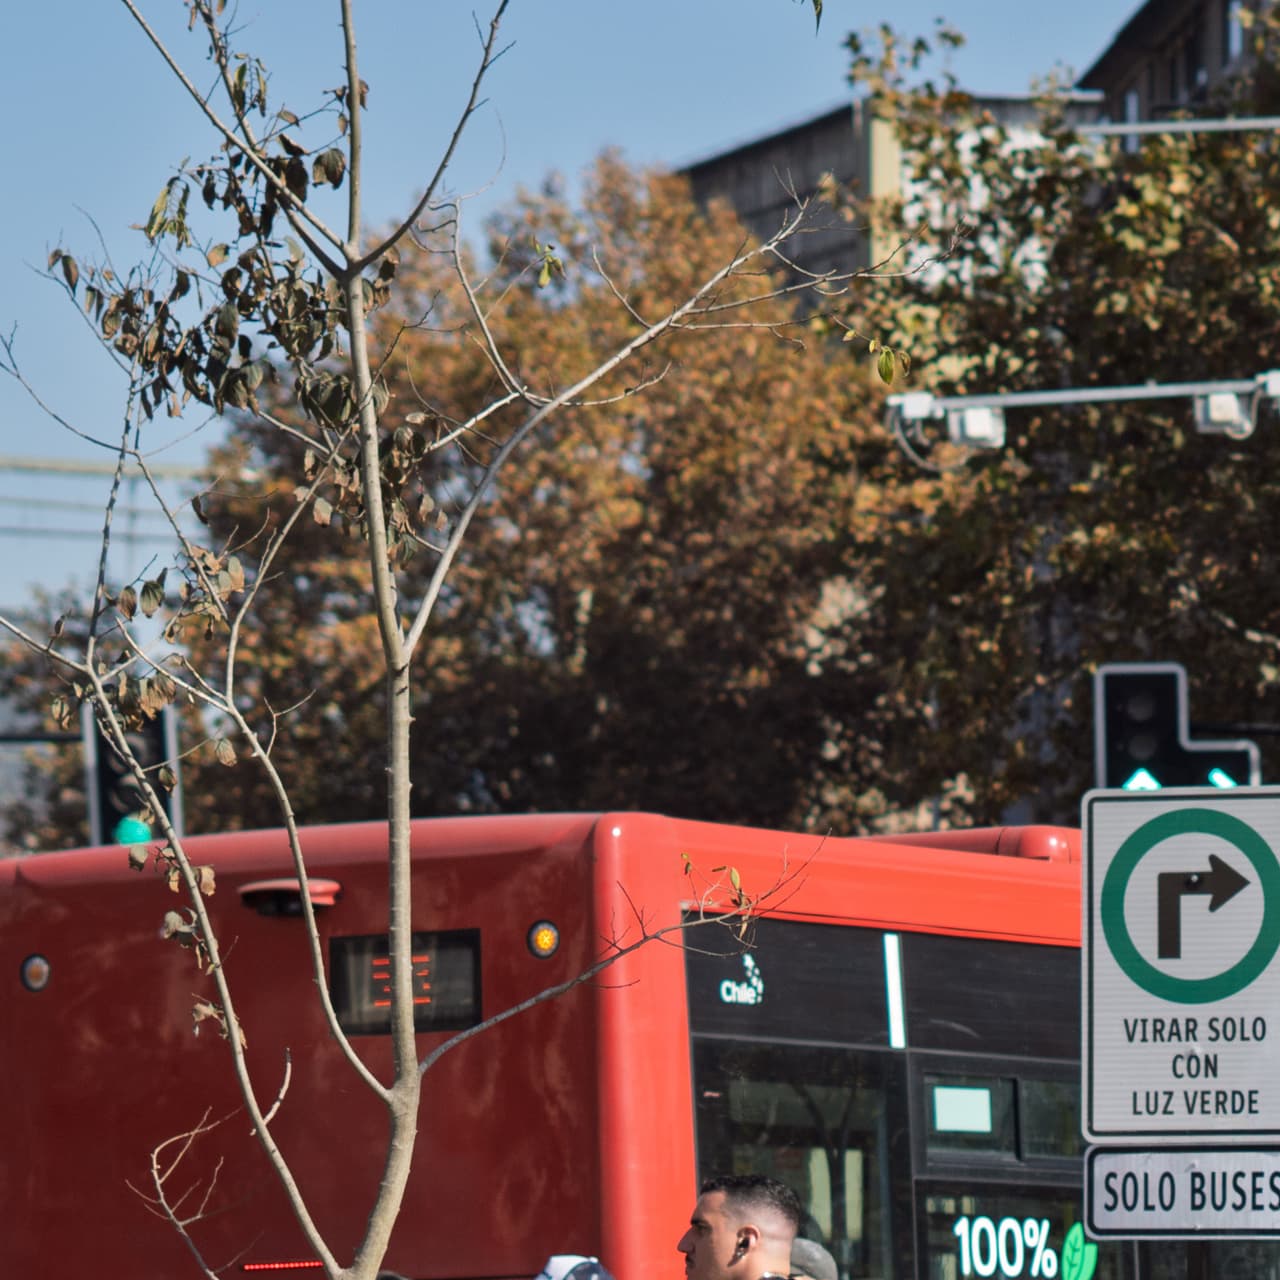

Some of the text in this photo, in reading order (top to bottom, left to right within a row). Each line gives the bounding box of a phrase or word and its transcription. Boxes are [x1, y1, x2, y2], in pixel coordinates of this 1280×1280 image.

[1123, 1016, 1267, 1043] VIRAR SOLO
[1172, 1054, 1219, 1079] CON
[1132, 1089, 1260, 1115] LUZ VERDE
[1104, 1171, 1177, 1212] SOLO
[954, 1217, 1057, 1279] 100%
